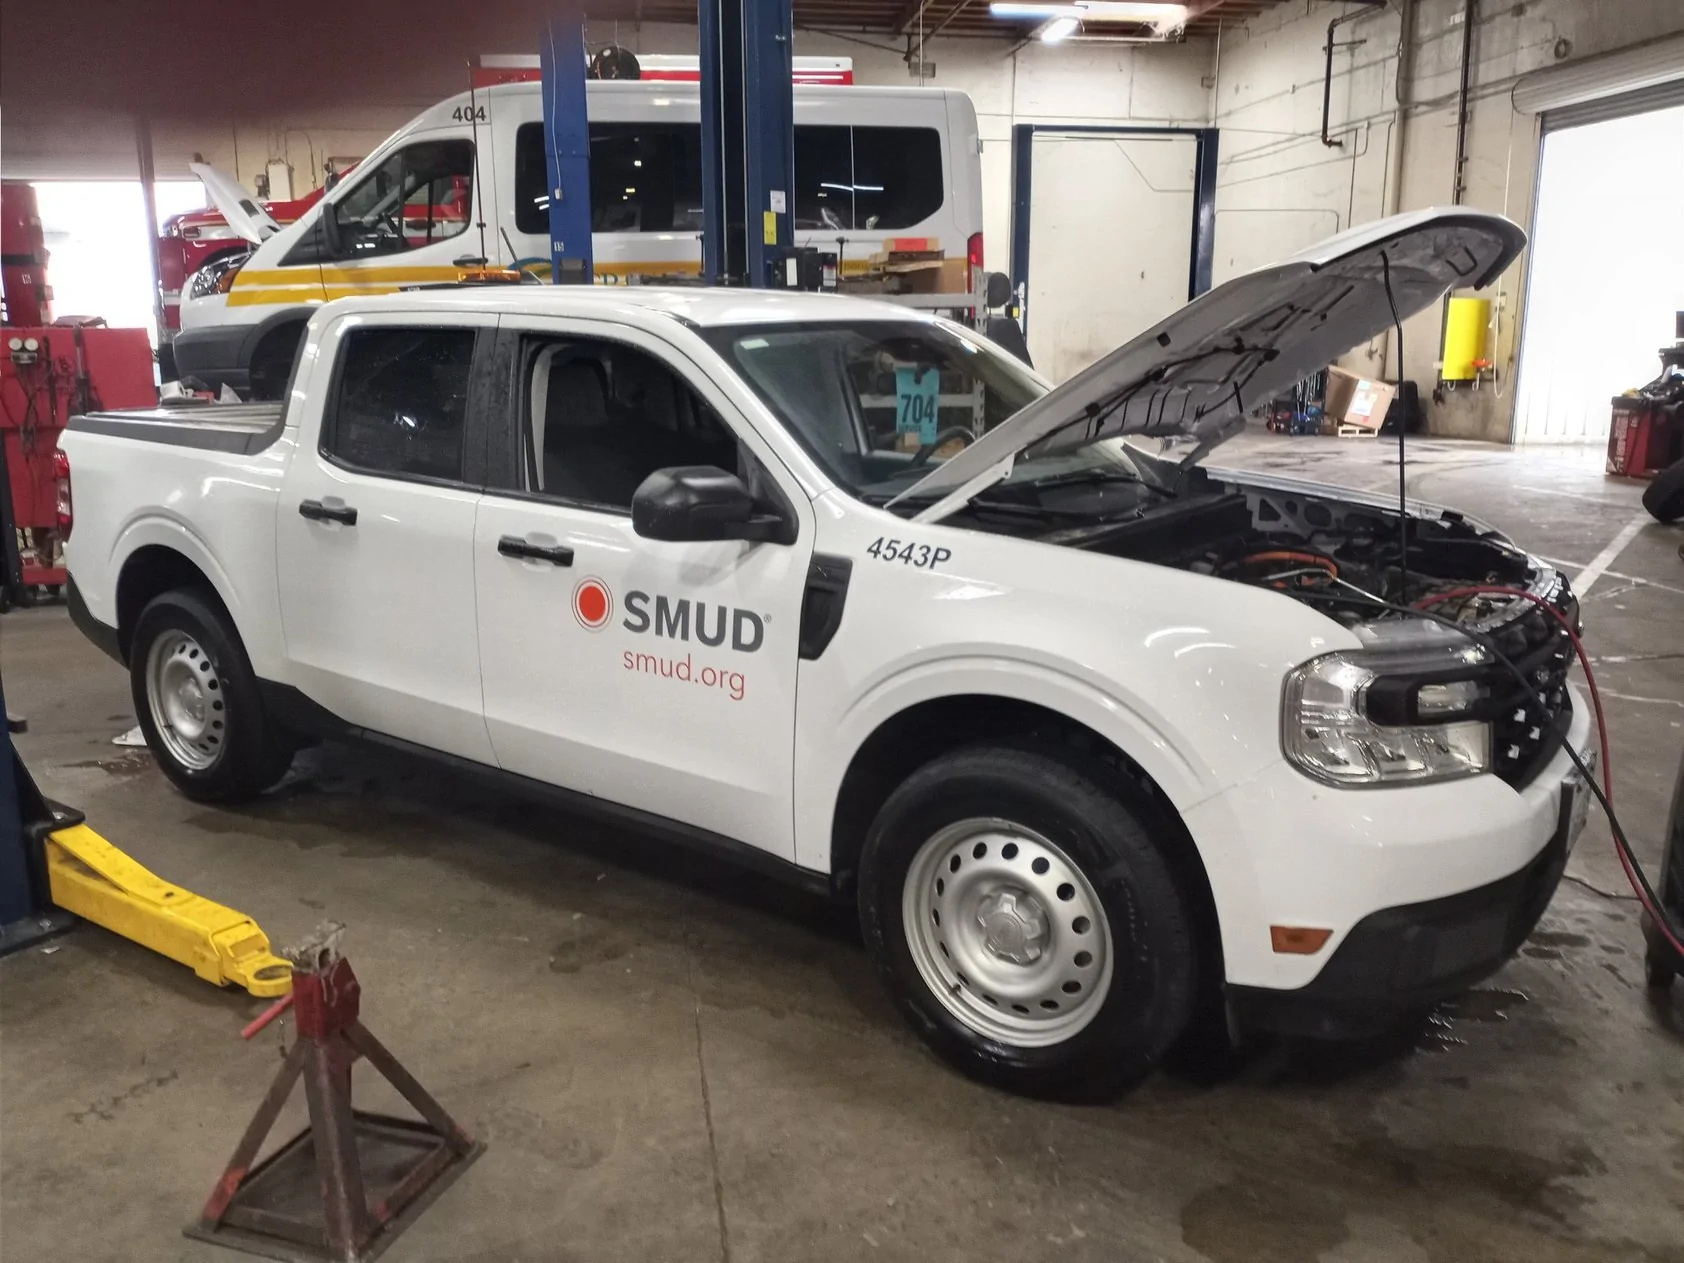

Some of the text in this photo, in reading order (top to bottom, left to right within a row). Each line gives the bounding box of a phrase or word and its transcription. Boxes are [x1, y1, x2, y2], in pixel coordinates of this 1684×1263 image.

[452, 105, 486, 122] 404
[901, 394, 935, 424] 704
[866, 536, 952, 570] 4543P
[623, 650, 745, 701] smud.org
